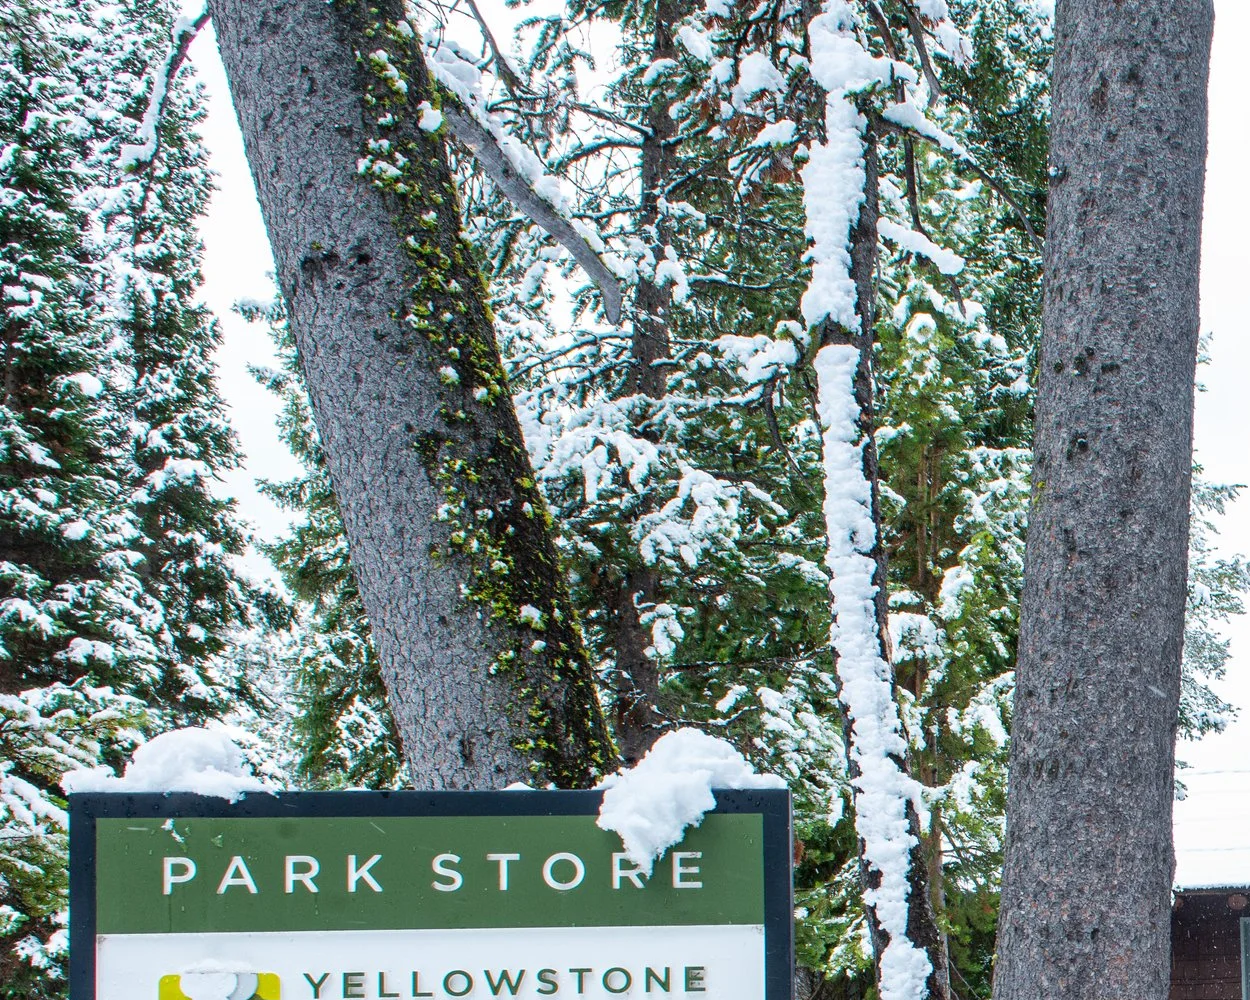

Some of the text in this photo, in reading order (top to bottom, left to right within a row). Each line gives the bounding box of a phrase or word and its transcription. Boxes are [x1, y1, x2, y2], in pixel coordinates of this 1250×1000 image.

[163, 851, 703, 895] PARK STORE
[303, 965, 707, 1000] YELLOWSTONE
